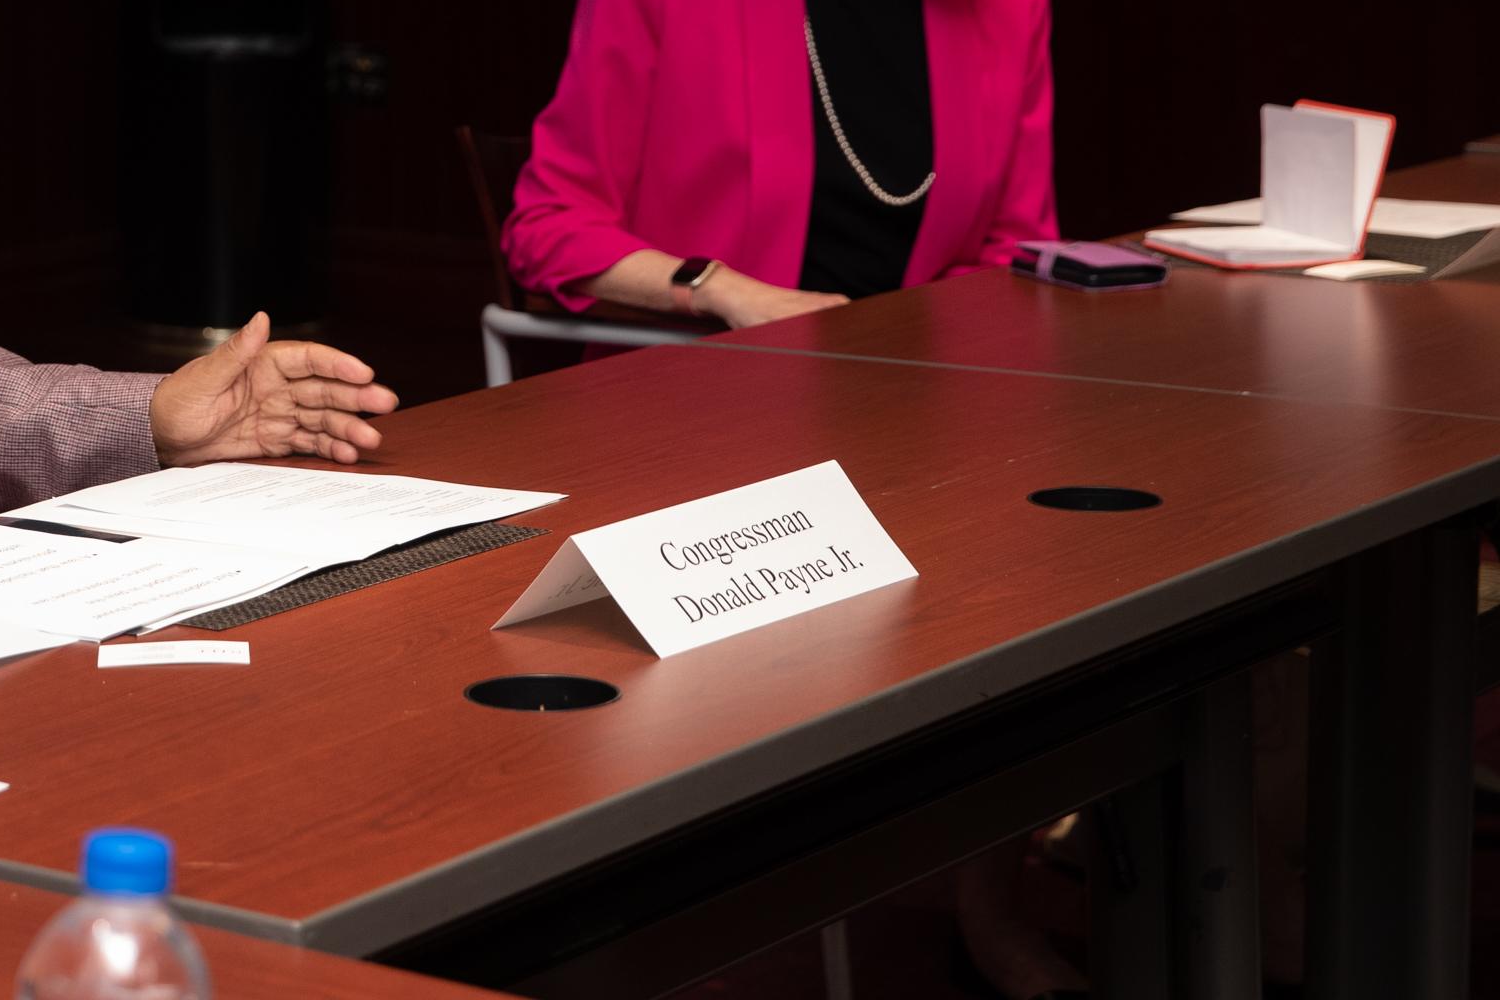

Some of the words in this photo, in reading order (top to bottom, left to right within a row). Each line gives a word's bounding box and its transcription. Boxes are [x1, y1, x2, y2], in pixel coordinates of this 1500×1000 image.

[659, 510, 815, 571] Congressman
[672, 573, 767, 623] Donald
[756, 560, 834, 596] Payne
[827, 545, 865, 573] Jr.
